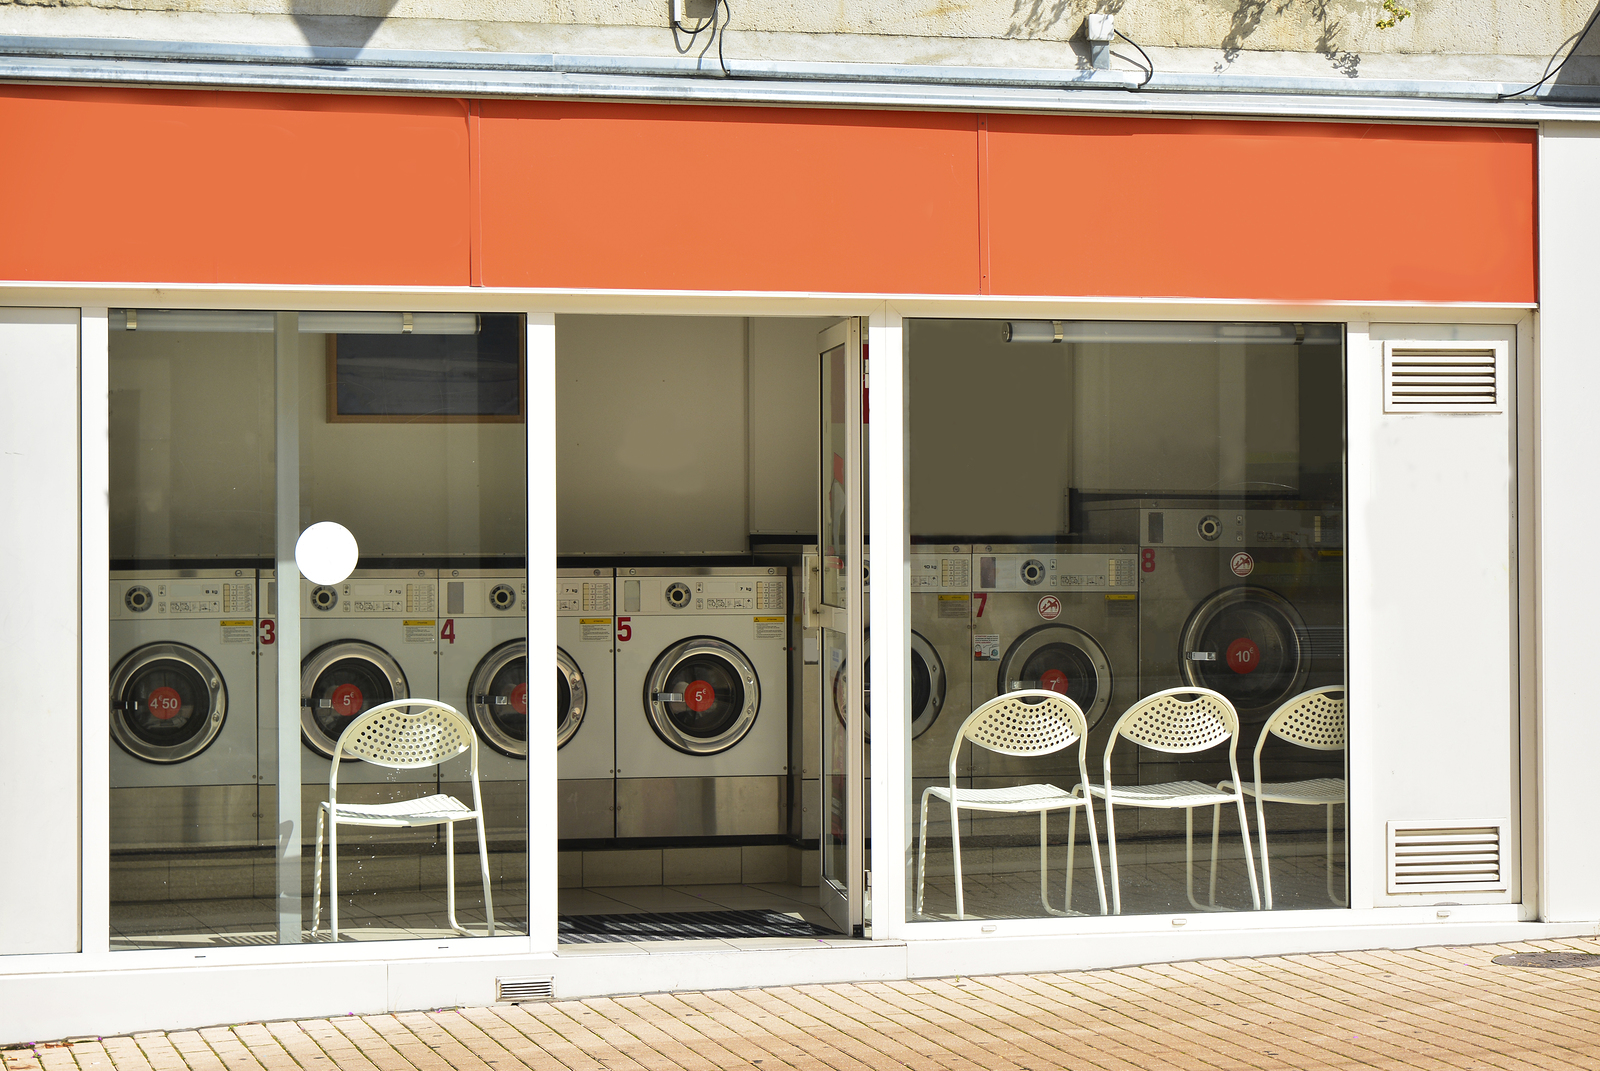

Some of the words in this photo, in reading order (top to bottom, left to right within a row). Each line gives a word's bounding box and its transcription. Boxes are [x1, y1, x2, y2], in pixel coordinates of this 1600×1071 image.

[1141, 548, 1155, 572] 8
[974, 593, 988, 617] 7
[260, 619, 276, 645] 3
[440, 619, 456, 644] 4
[617, 617, 632, 642] 5
